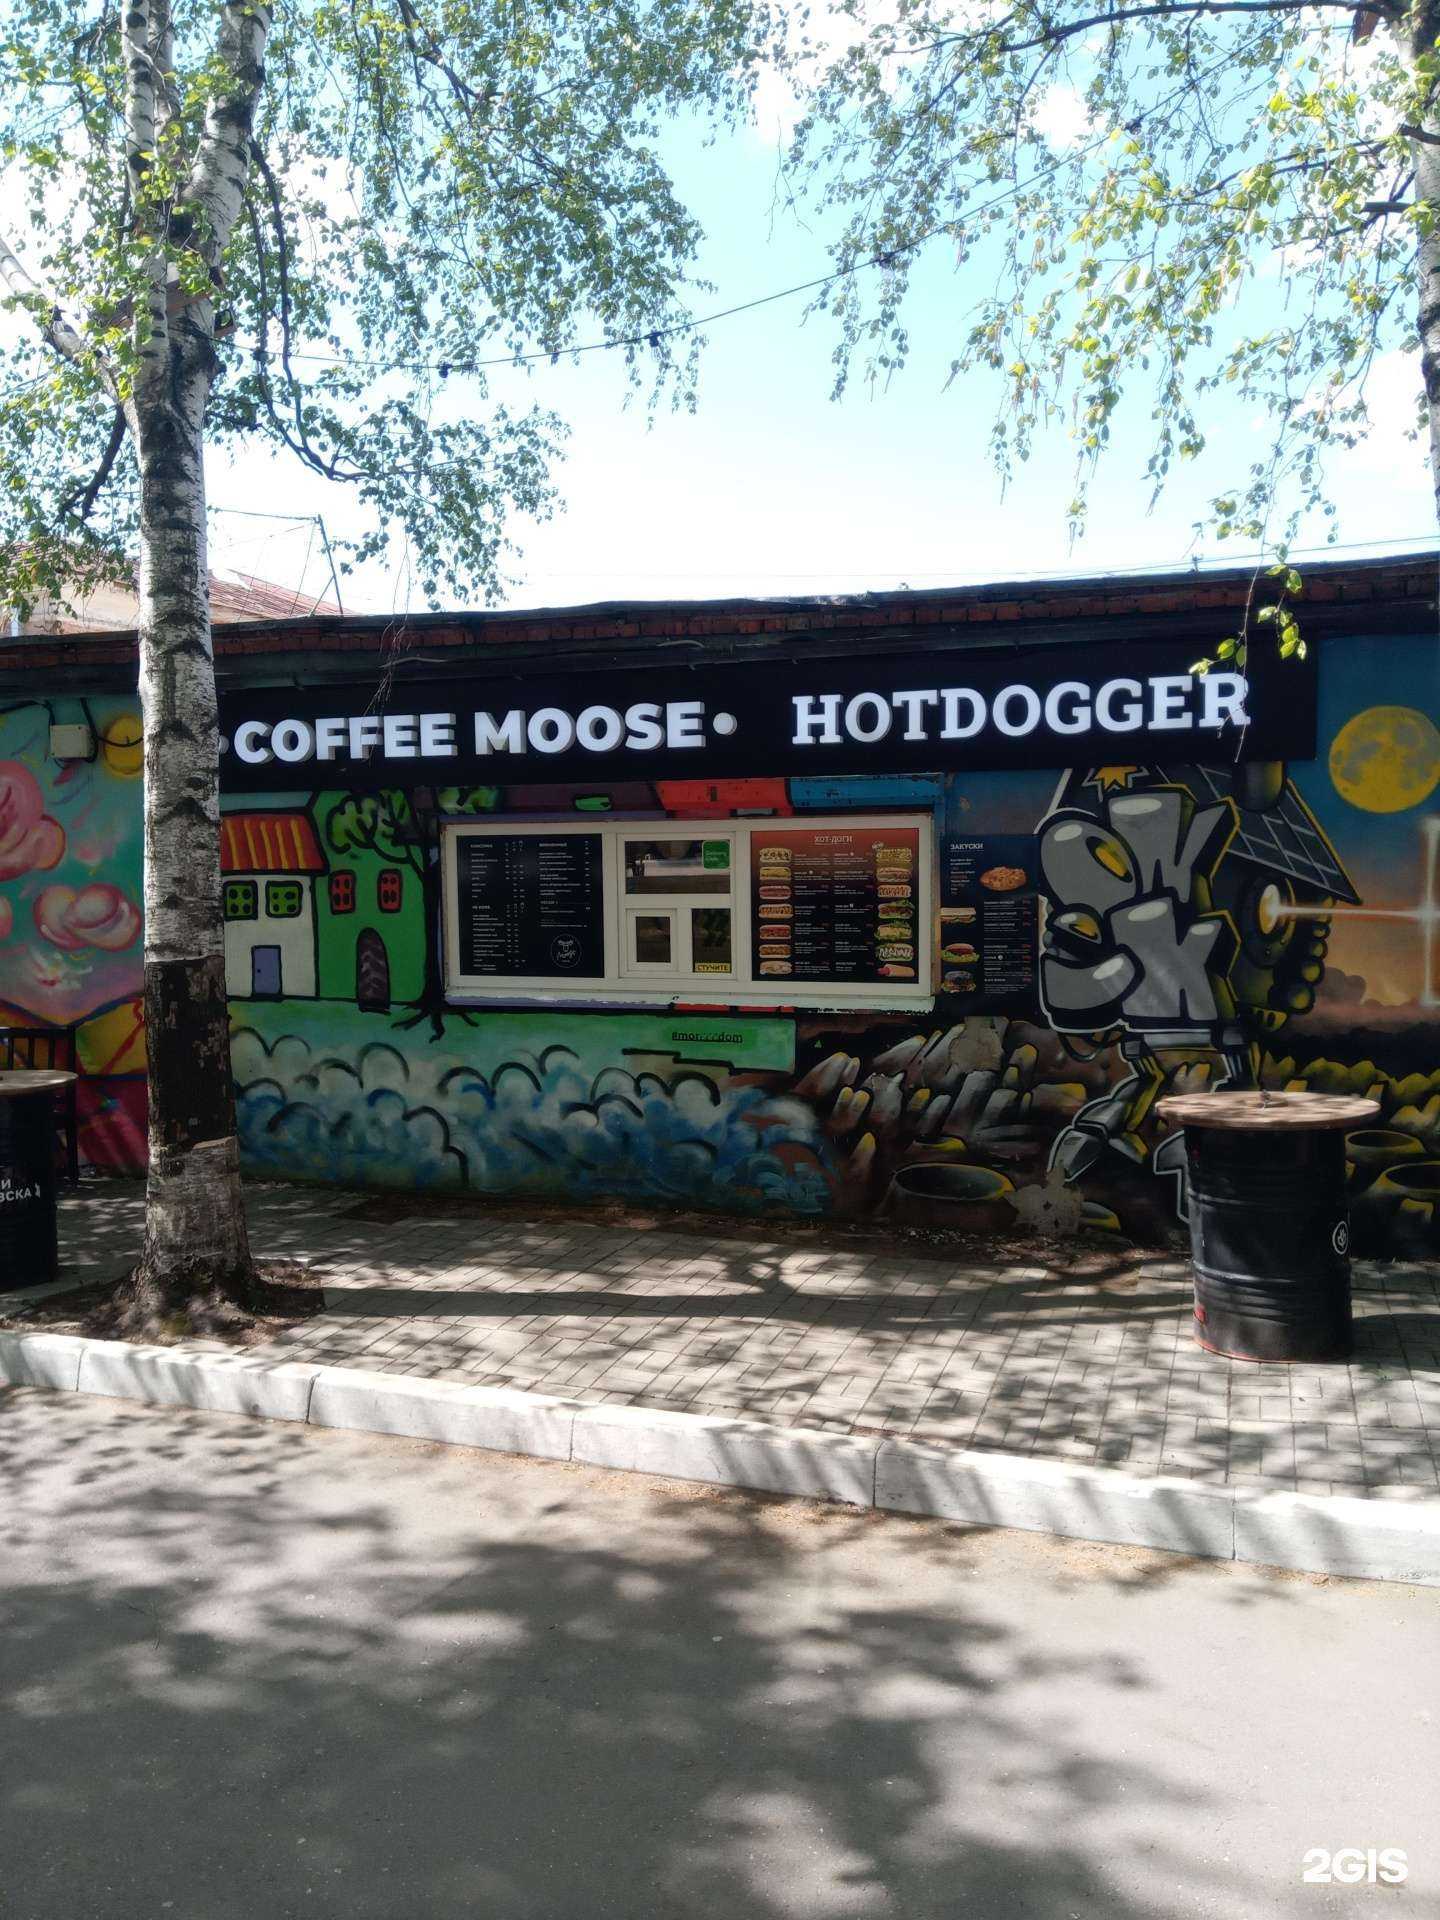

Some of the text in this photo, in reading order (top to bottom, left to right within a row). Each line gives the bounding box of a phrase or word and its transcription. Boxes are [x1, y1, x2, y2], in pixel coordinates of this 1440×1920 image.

[792, 672, 1251, 746] HOTDOGGER
[232, 700, 706, 765] COFFEE MOOSE
[814, 835, 853, 843] ХОТ-ДОГИ
[949, 842, 984, 851] ЗАКУСКИ
